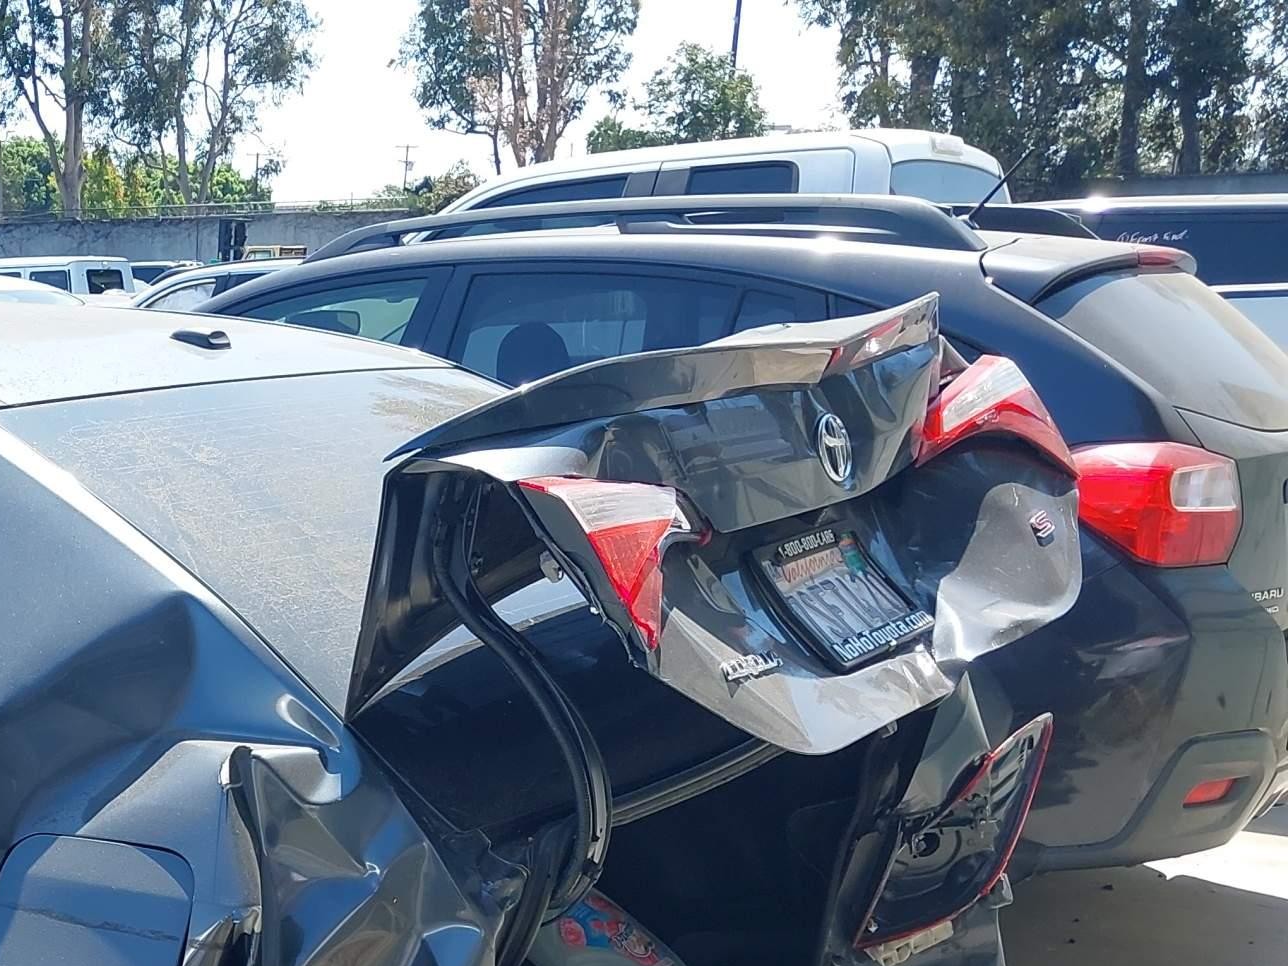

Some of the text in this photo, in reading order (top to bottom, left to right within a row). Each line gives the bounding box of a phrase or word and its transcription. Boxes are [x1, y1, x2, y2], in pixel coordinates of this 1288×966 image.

[1030, 510, 1055, 537] S
[1252, 588, 1284, 602] BARU
[833, 610, 934, 662] NoHoToyota.com
